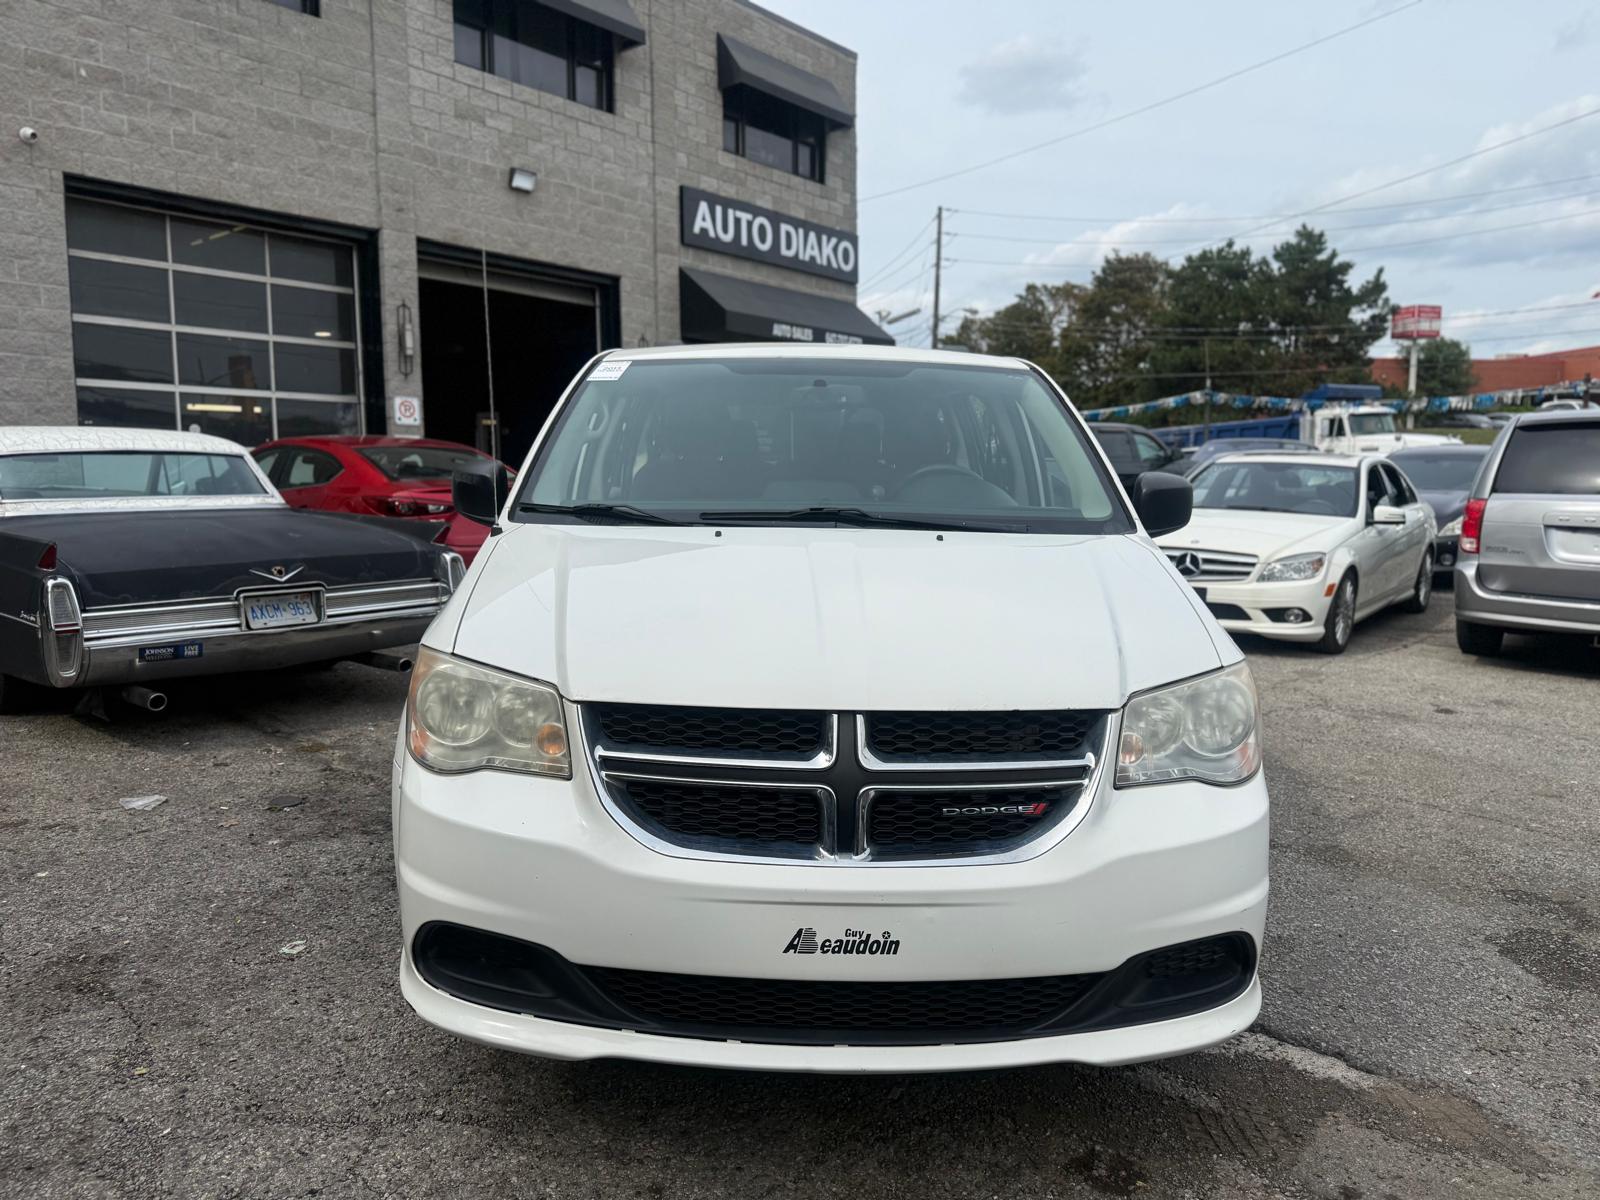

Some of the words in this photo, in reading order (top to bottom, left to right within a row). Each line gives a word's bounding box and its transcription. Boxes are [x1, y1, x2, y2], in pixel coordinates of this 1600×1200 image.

[693, 200, 773, 252] AUTO
[779, 222, 855, 273] DIAKO
[772, 323, 792, 338] AUTO
[792, 325, 813, 342] SALES
[250, 603, 283, 621] AXCM
[287, 601, 313, 617] 963
[144, 647, 174, 656] JOHNSON
[942, 804, 1035, 815] DODGE
[844, 928, 865, 940] Guy
